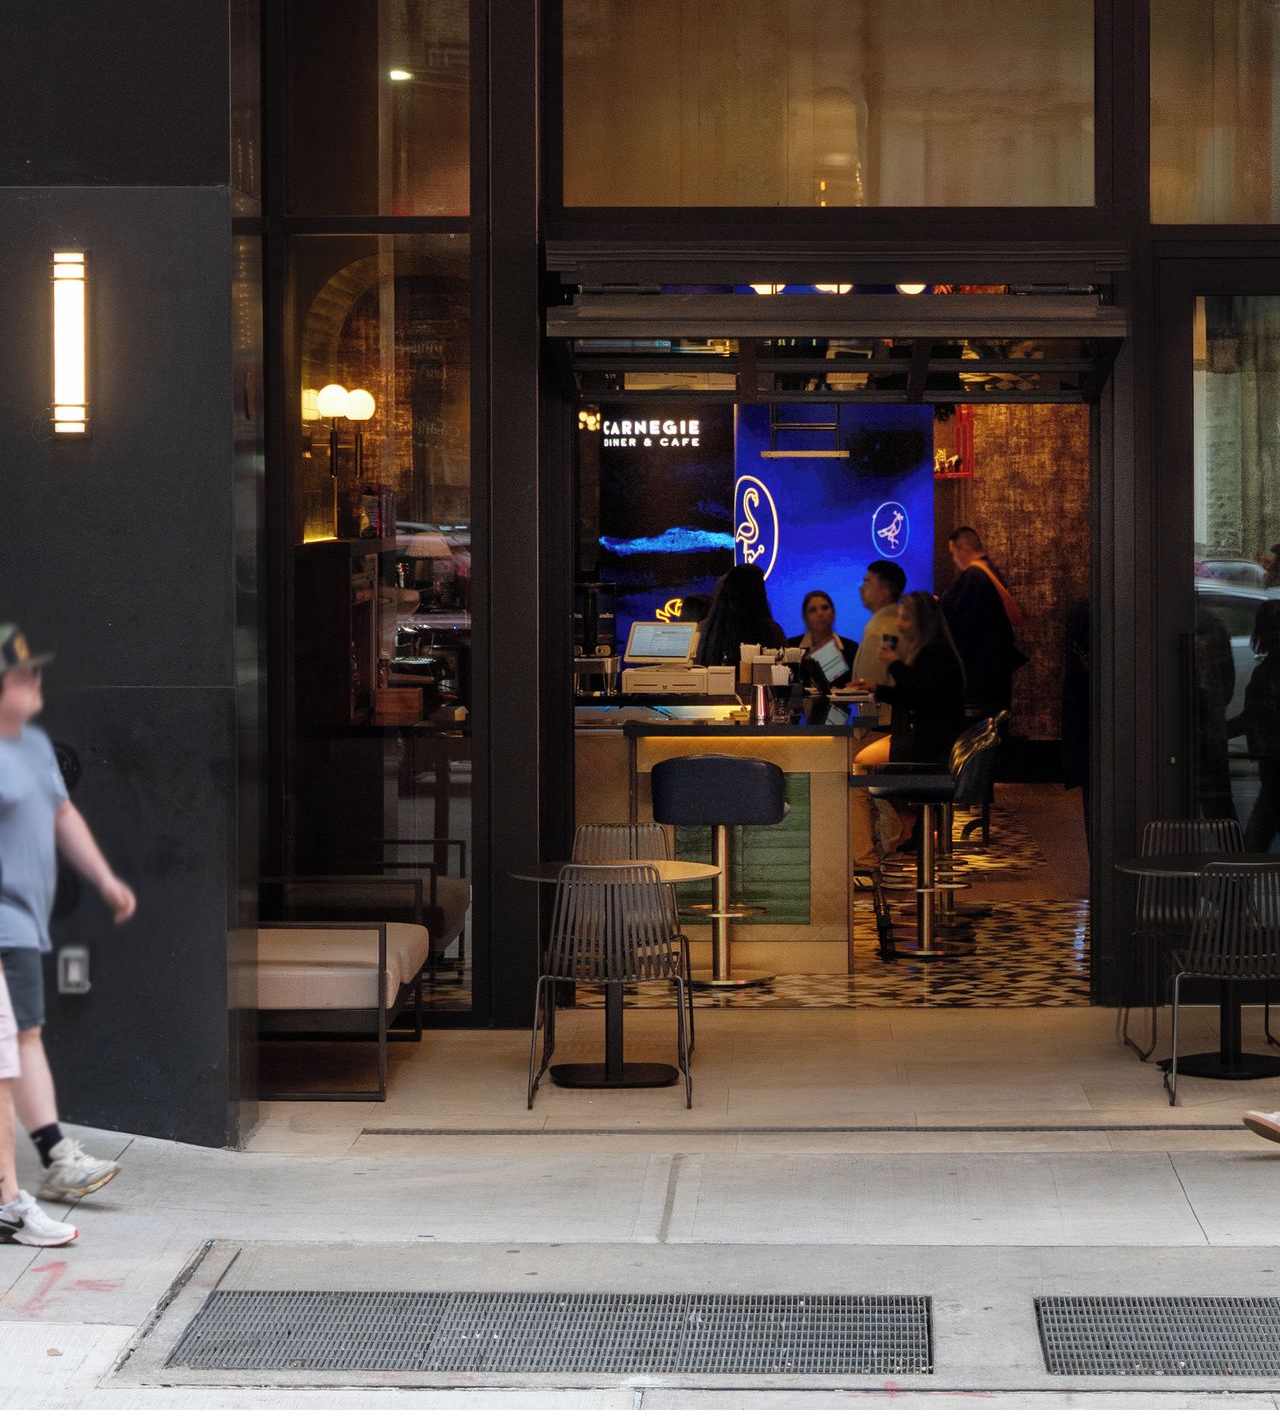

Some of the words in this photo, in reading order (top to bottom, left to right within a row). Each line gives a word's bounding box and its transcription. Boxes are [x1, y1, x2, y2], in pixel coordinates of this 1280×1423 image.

[602, 419, 700, 436] CARNEGIE
[603, 437, 637, 448] DINER
[643, 438, 652, 447] &
[659, 437, 700, 447] CAFE
